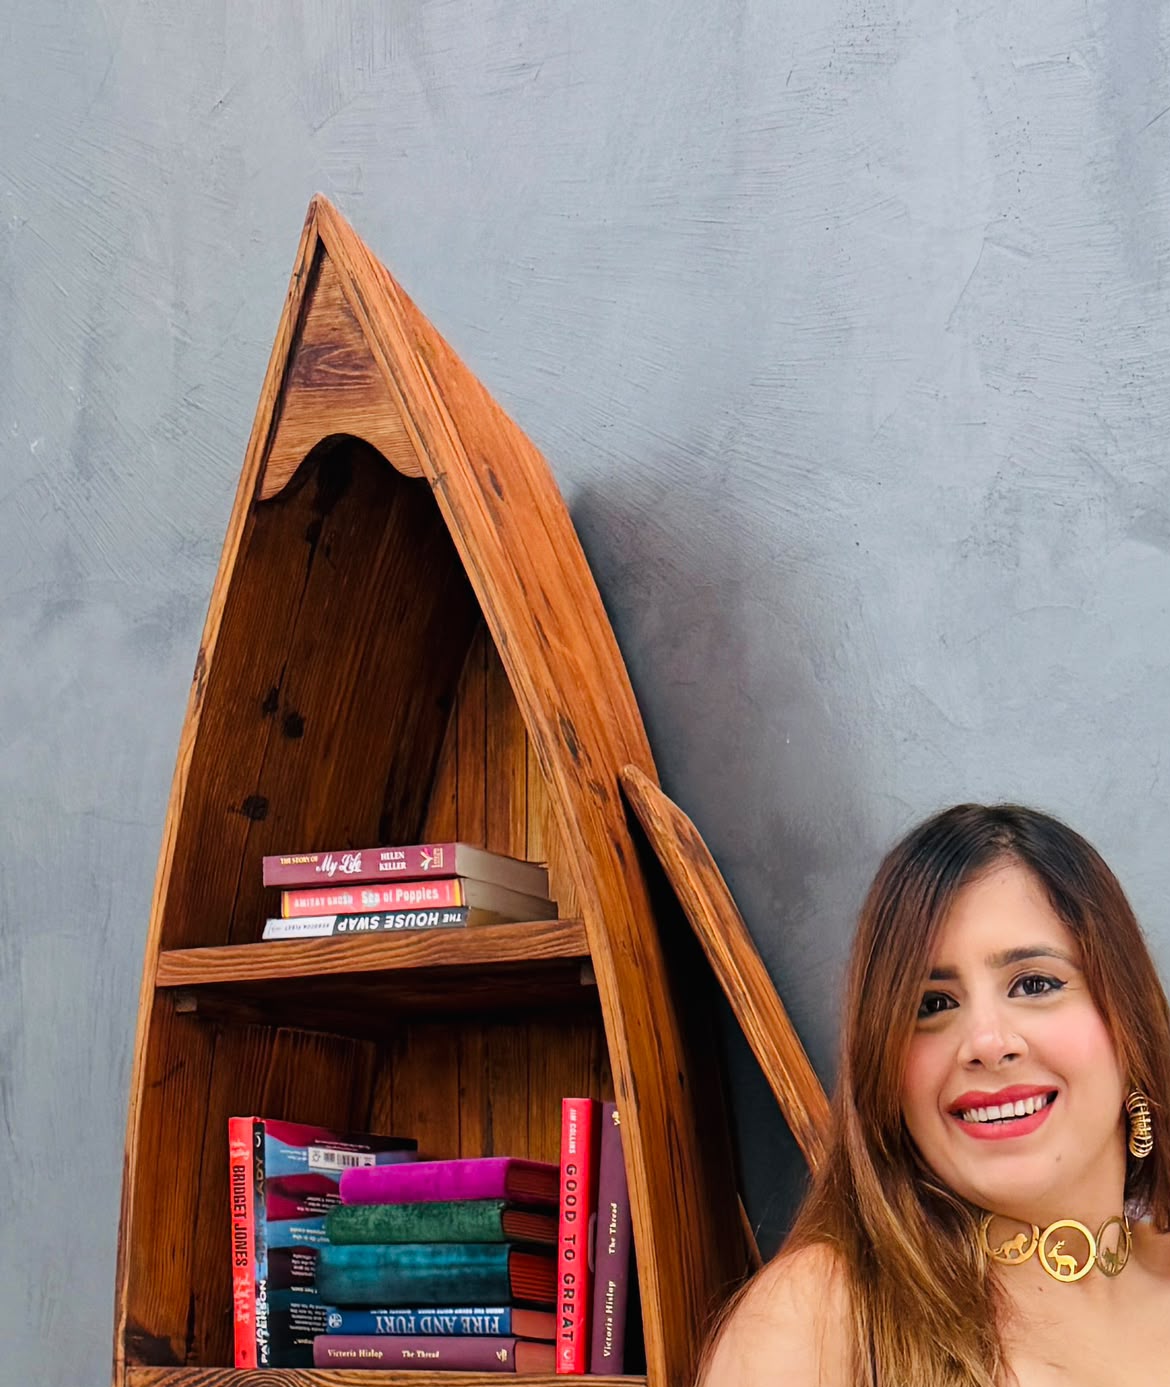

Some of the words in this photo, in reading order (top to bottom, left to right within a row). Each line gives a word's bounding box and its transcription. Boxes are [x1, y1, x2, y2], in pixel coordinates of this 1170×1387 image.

[315, 854, 338, 877] My
[339, 852, 362, 874] Life
[380, 851, 405, 860] HELEN
[379, 862, 406, 871] KELLER
[383, 890, 392, 902] of
[396, 887, 439, 904] Poppies
[338, 916, 380, 932] SWAP
[384, 912, 439, 929] HOUSE
[442, 913, 462, 923] THE
[568, 1123, 577, 1154] COLLINS
[233, 1165, 246, 1219] BRIDGET
[565, 1164, 578, 1222] GOOD
[609, 1202, 618, 1234] Thread
[234, 1224, 248, 1266] JONES
[564, 1234, 576, 1260] TO
[608, 1237, 616, 1255] The
[606, 1280, 616, 1314] Hislop
[562, 1272, 576, 1342] GREAT
[376, 1316, 416, 1334] FURY
[420, 1316, 456, 1334] AND
[460, 1316, 500, 1334] FIRE
[603, 1318, 613, 1358] Victoria
[328, 1348, 356, 1358] Victoria
[359, 1348, 384, 1359] Hislop
[402, 1350, 414, 1358] The
[416, 1350, 440, 1358] Thread
